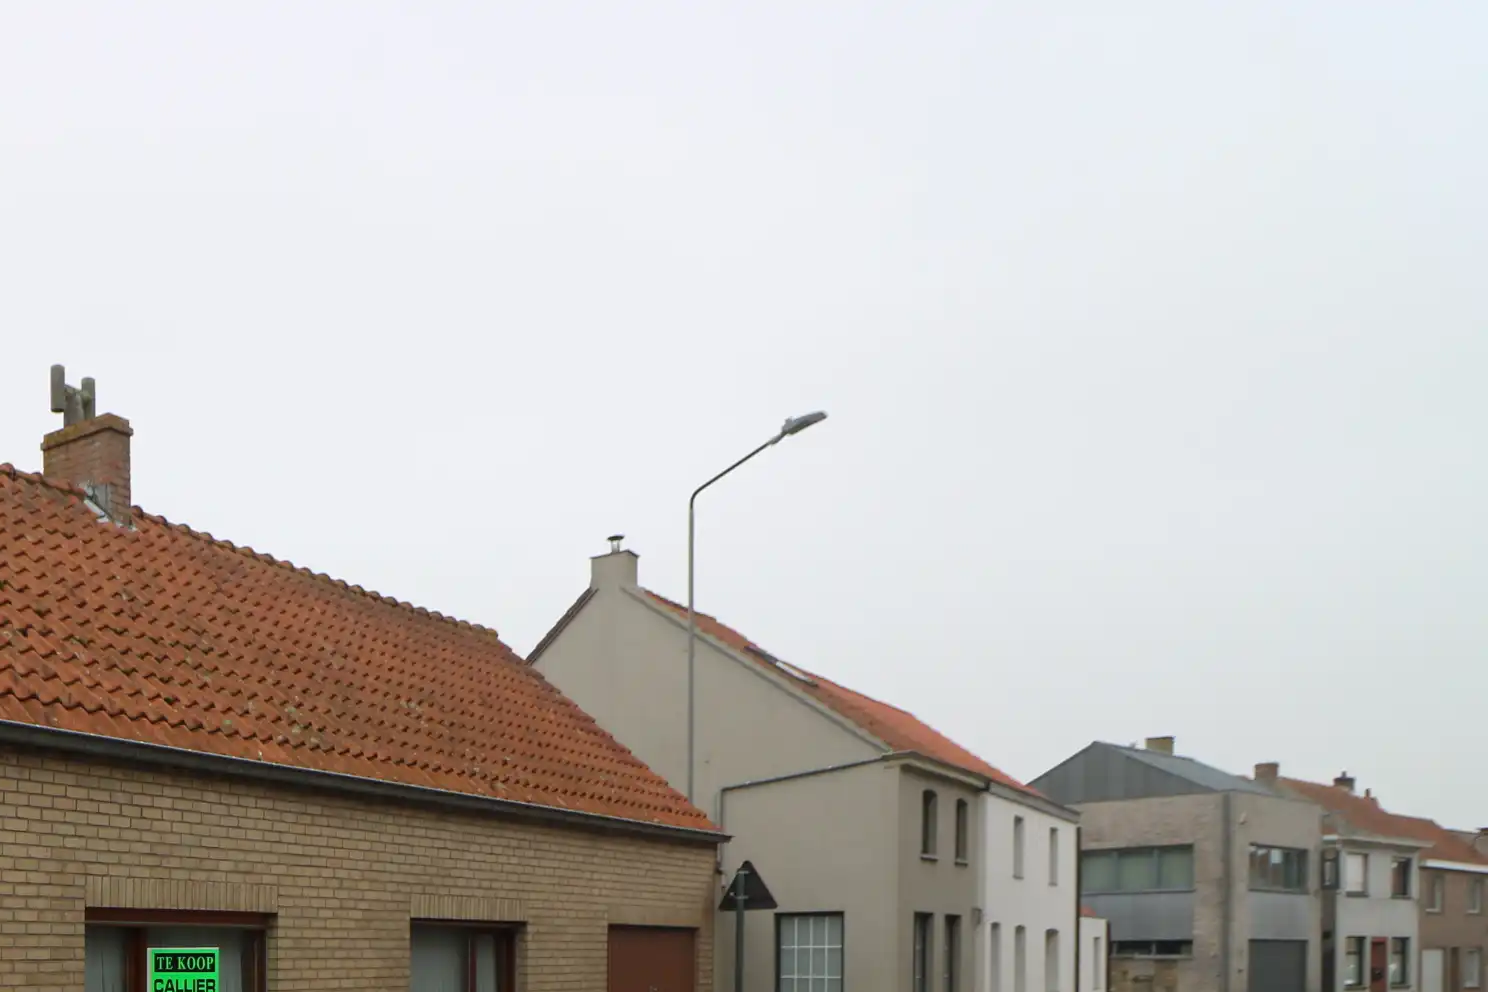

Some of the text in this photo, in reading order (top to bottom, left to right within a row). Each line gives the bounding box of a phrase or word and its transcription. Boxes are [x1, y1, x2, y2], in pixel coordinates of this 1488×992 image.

[157, 956, 214, 970] TE KOOP
[154, 979, 215, 992] CALLIER
